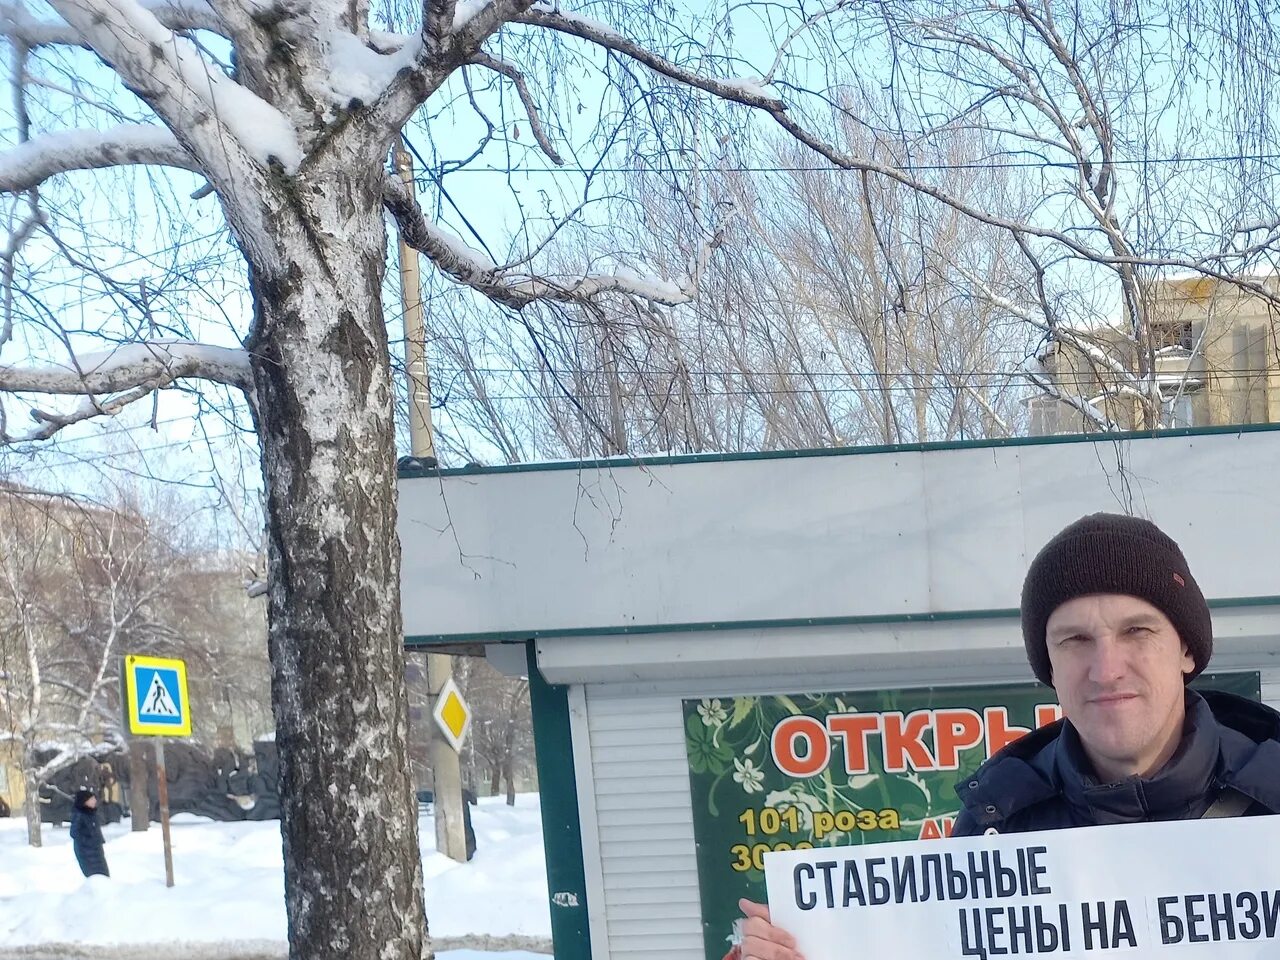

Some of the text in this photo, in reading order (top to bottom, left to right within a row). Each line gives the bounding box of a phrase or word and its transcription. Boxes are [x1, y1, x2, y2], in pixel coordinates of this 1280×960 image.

[739, 807, 900, 839] 101 роза
[793, 846, 1051, 911] СТАБИЛЬНЫЕ
[960, 903, 1071, 960] ЦЕНЫ
[1082, 900, 1137, 950] НА
